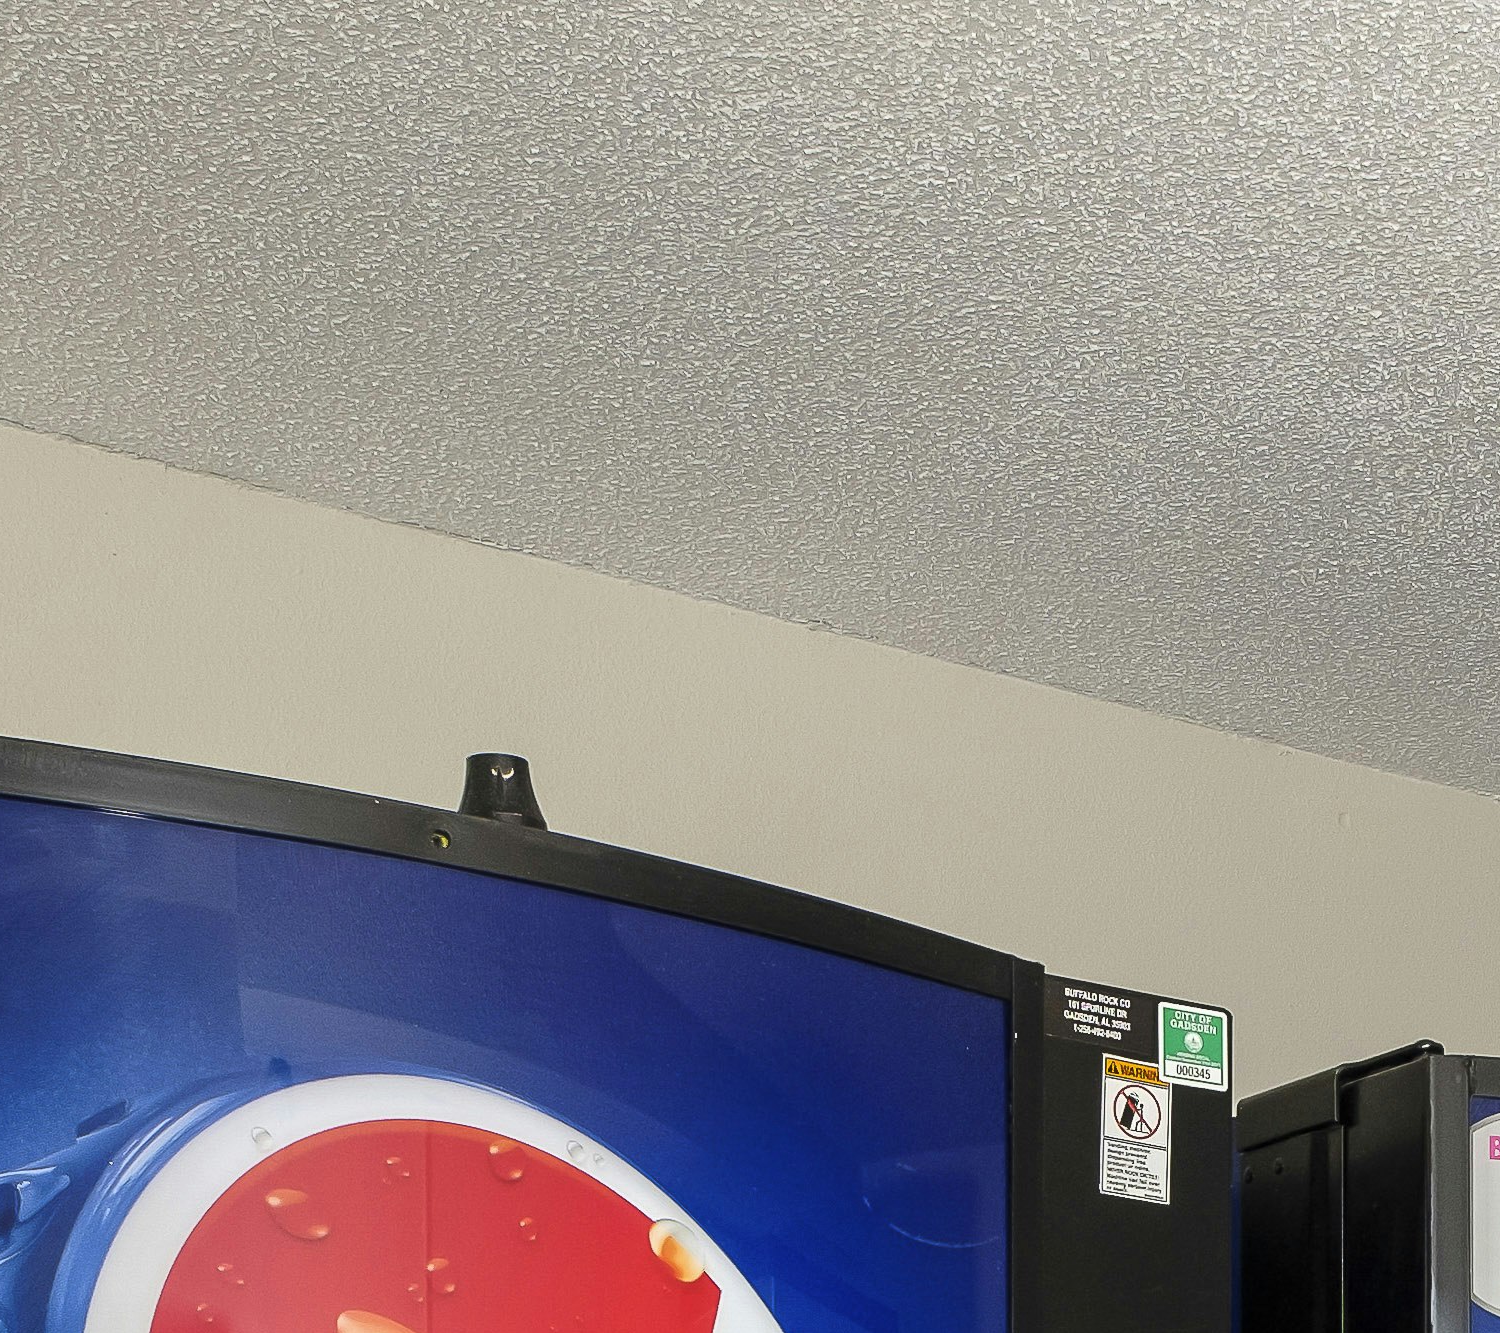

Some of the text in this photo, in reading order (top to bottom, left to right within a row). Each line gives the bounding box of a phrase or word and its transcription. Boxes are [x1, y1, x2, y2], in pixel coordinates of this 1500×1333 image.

[1120, 999, 1131, 1008] CO
[1174, 1010, 1213, 1025] CITY OF
[1170, 1018, 1217, 1036] GADSDEN
[1176, 1064, 1211, 1080] 000345
